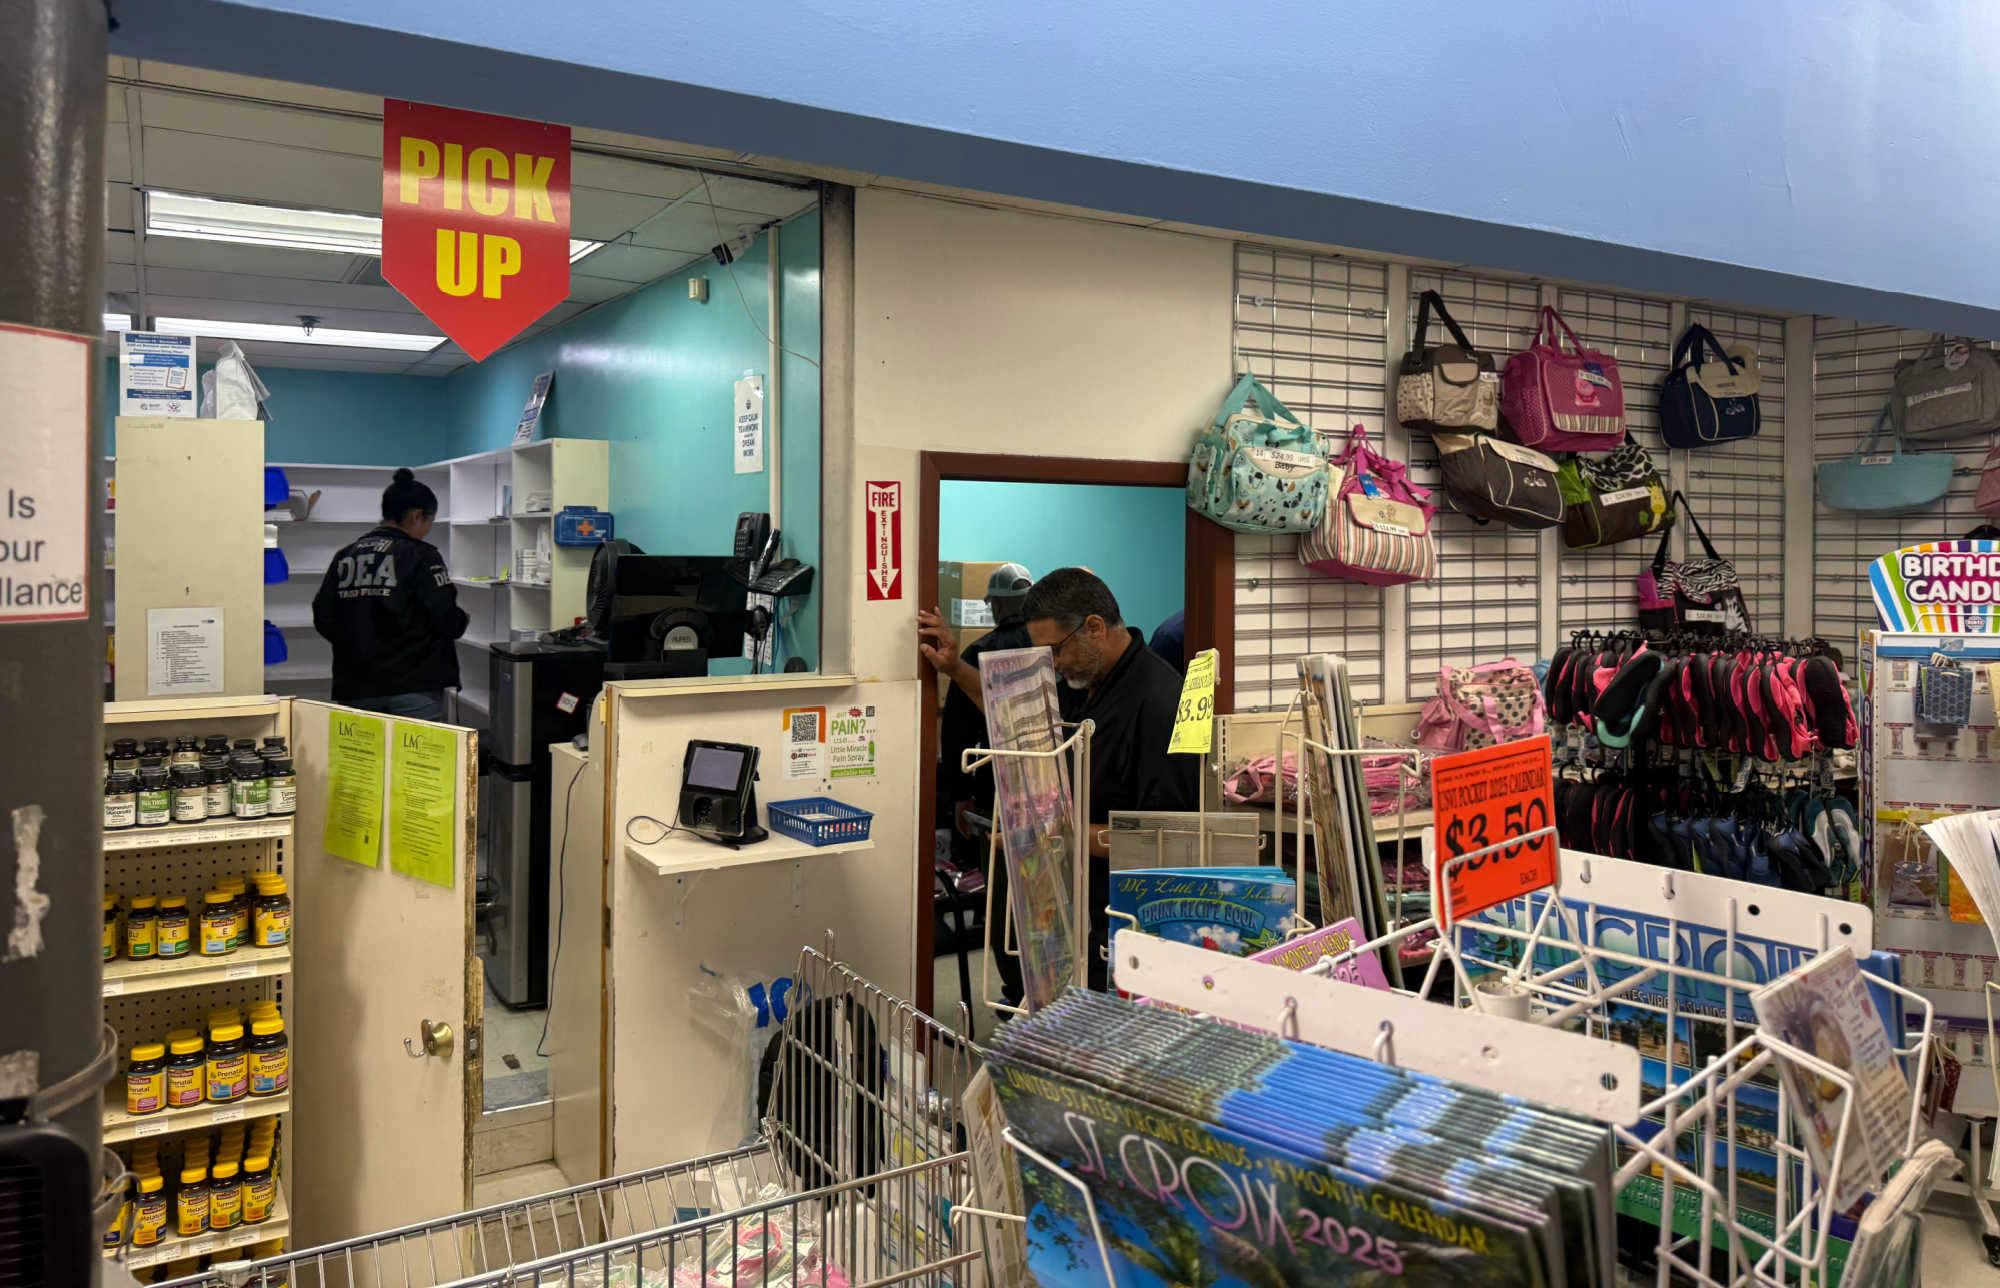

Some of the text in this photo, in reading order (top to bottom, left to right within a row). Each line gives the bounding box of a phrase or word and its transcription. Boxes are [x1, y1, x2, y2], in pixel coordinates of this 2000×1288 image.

[400, 136, 556, 223] PICK
[436, 228, 521, 299] UP
[9, 488, 36, 519] Is
[872, 492, 896, 507] FIRE
[337, 554, 398, 588] DEA
[1510, 768, 1545, 795] CALENDAR
[1446, 798, 1547, 883] $3.50
[1155, 880, 1194, 894] Little
[1142, 899, 1258, 929] DRINK RECIPE BOOK
[1313, 927, 1353, 961] CALENDAR
[217, 1068, 244, 1078] Prenatal
[261, 1061, 286, 1071] Prenatal
[1005, 1067, 1060, 1103] UNITED
[1060, 1085, 1119, 1124] STATES
[1120, 1107, 1179, 1145] VIRGIN
[1179, 1126, 1253, 1171] ISLANDS
[1290, 1165, 1369, 1211] MONTH
[1371, 1194, 1489, 1254] CALENDAR
[1063, 1112, 1404, 1276] ST. CROIX 2025
